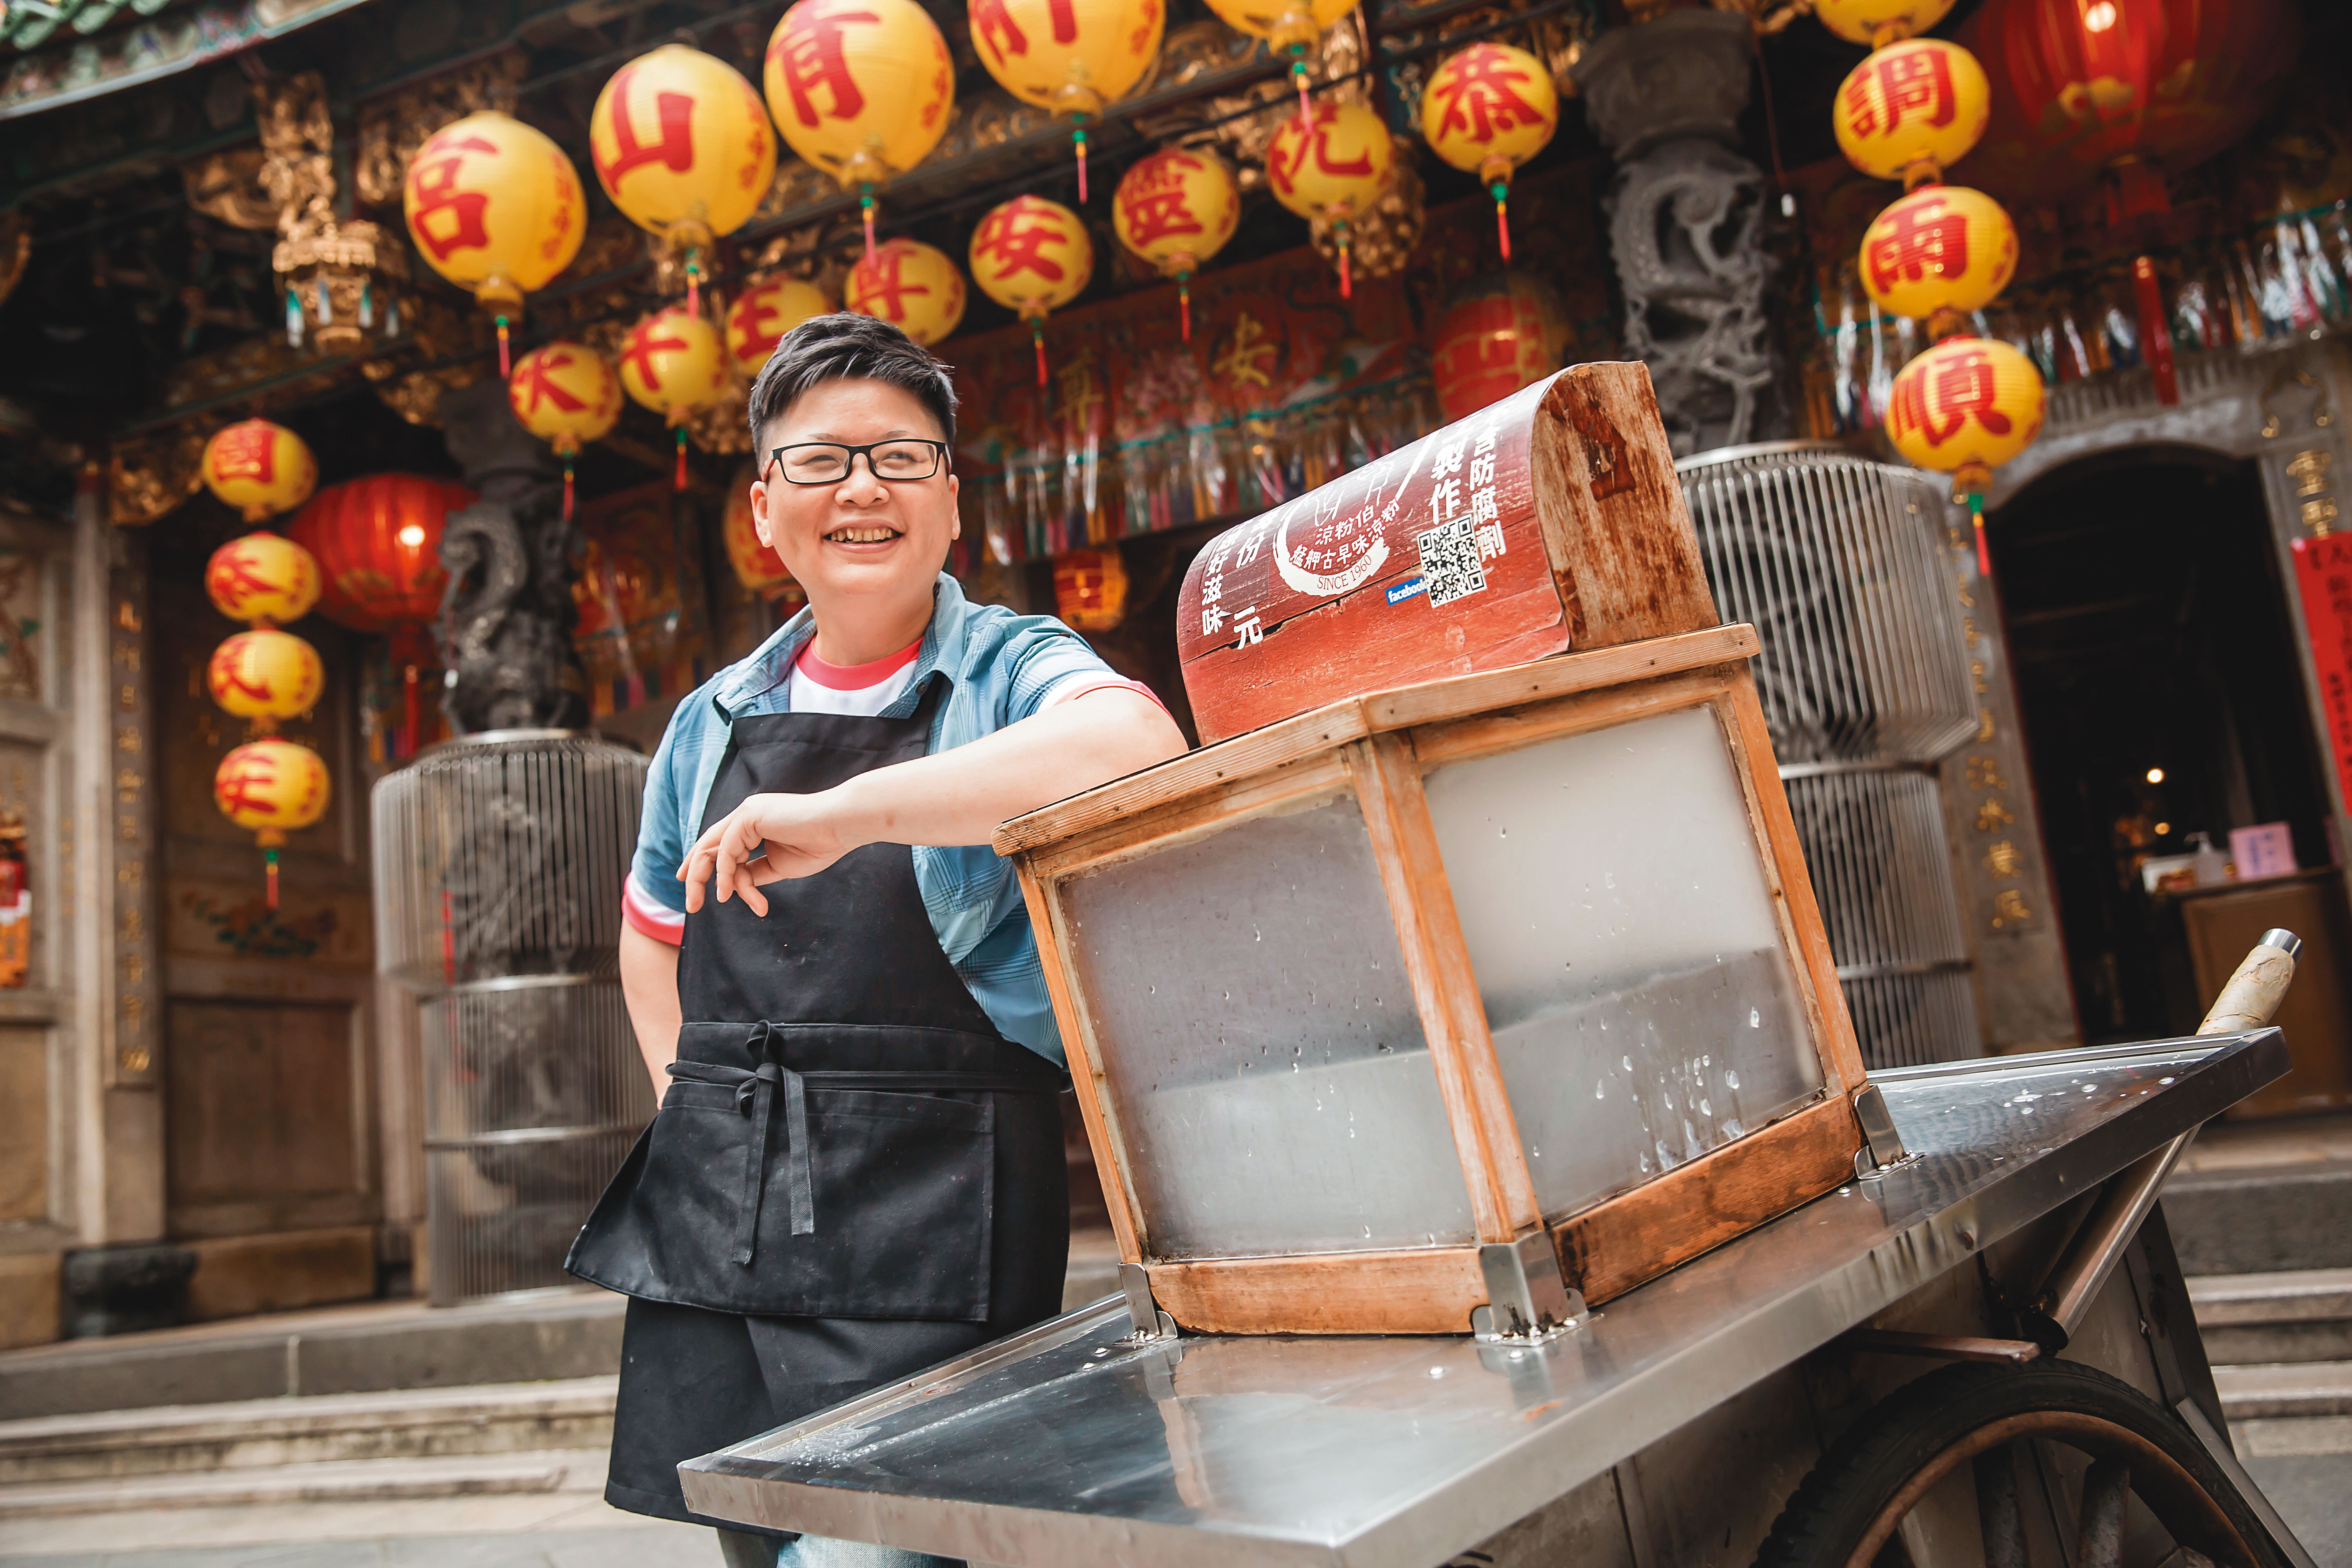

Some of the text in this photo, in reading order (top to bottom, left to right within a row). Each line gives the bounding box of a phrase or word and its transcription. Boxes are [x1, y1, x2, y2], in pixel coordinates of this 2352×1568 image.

[591, 67, 695, 195] 山
[1434, 46, 1544, 144] 恭
[1845, 48, 1955, 138] 調
[412, 129, 499, 261] 宮
[1117, 151, 1203, 248] 靈
[975, 198, 1067, 282] 安
[1869, 197, 1966, 294] 雨
[621, 308, 688, 392] 千
[1891, 352, 2012, 448] 順
[1289, 497, 1400, 572] 艋舺古早味涼粉
[1315, 505, 1374, 547] 涼粉伯
[1317, 554, 1373, 591] SINCE 1960
[1388, 578, 1426, 604] facebook
[1234, 606, 1263, 650] 元
